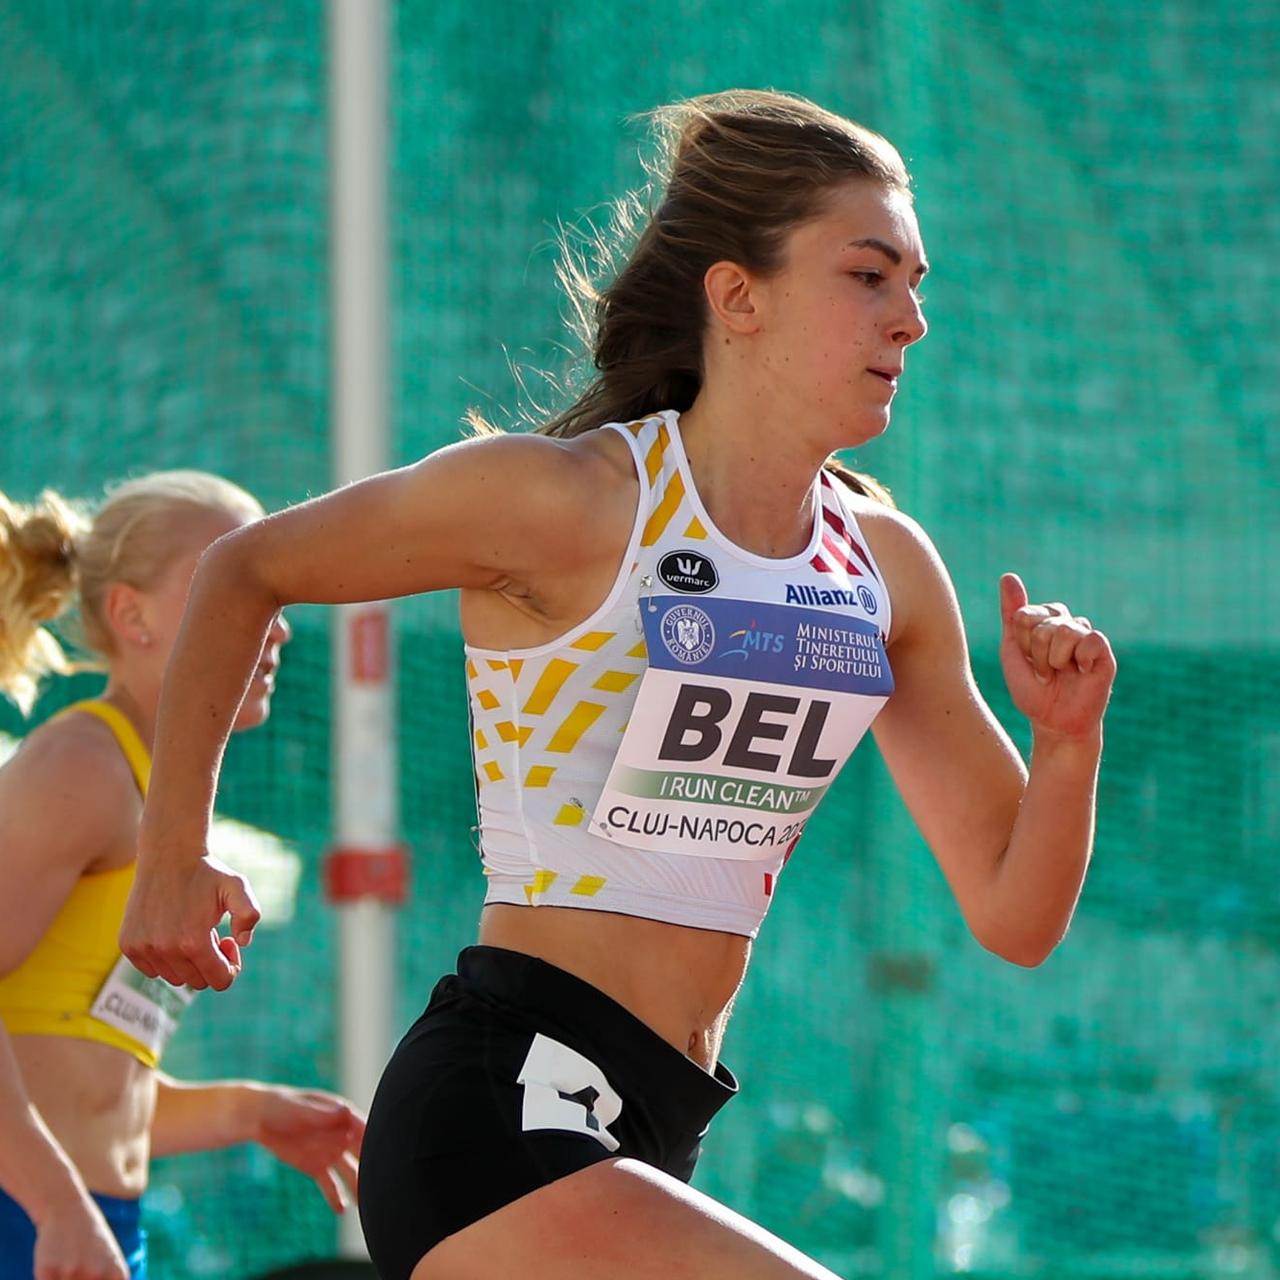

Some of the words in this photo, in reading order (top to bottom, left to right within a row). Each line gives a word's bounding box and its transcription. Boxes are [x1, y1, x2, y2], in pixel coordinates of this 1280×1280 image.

[666, 574, 710, 586] vermarc
[786, 584, 857, 606] Allianz
[742, 631, 784, 653] MTS
[796, 637, 880, 664] TINERETULUI
[810, 655, 882, 678] SPORTULUI
[657, 683, 838, 778] BEL
[660, 776, 668, 796] I
[670, 776, 717, 800] RUN
[607, 806, 777, 847] CLUJ-NAPOCA
